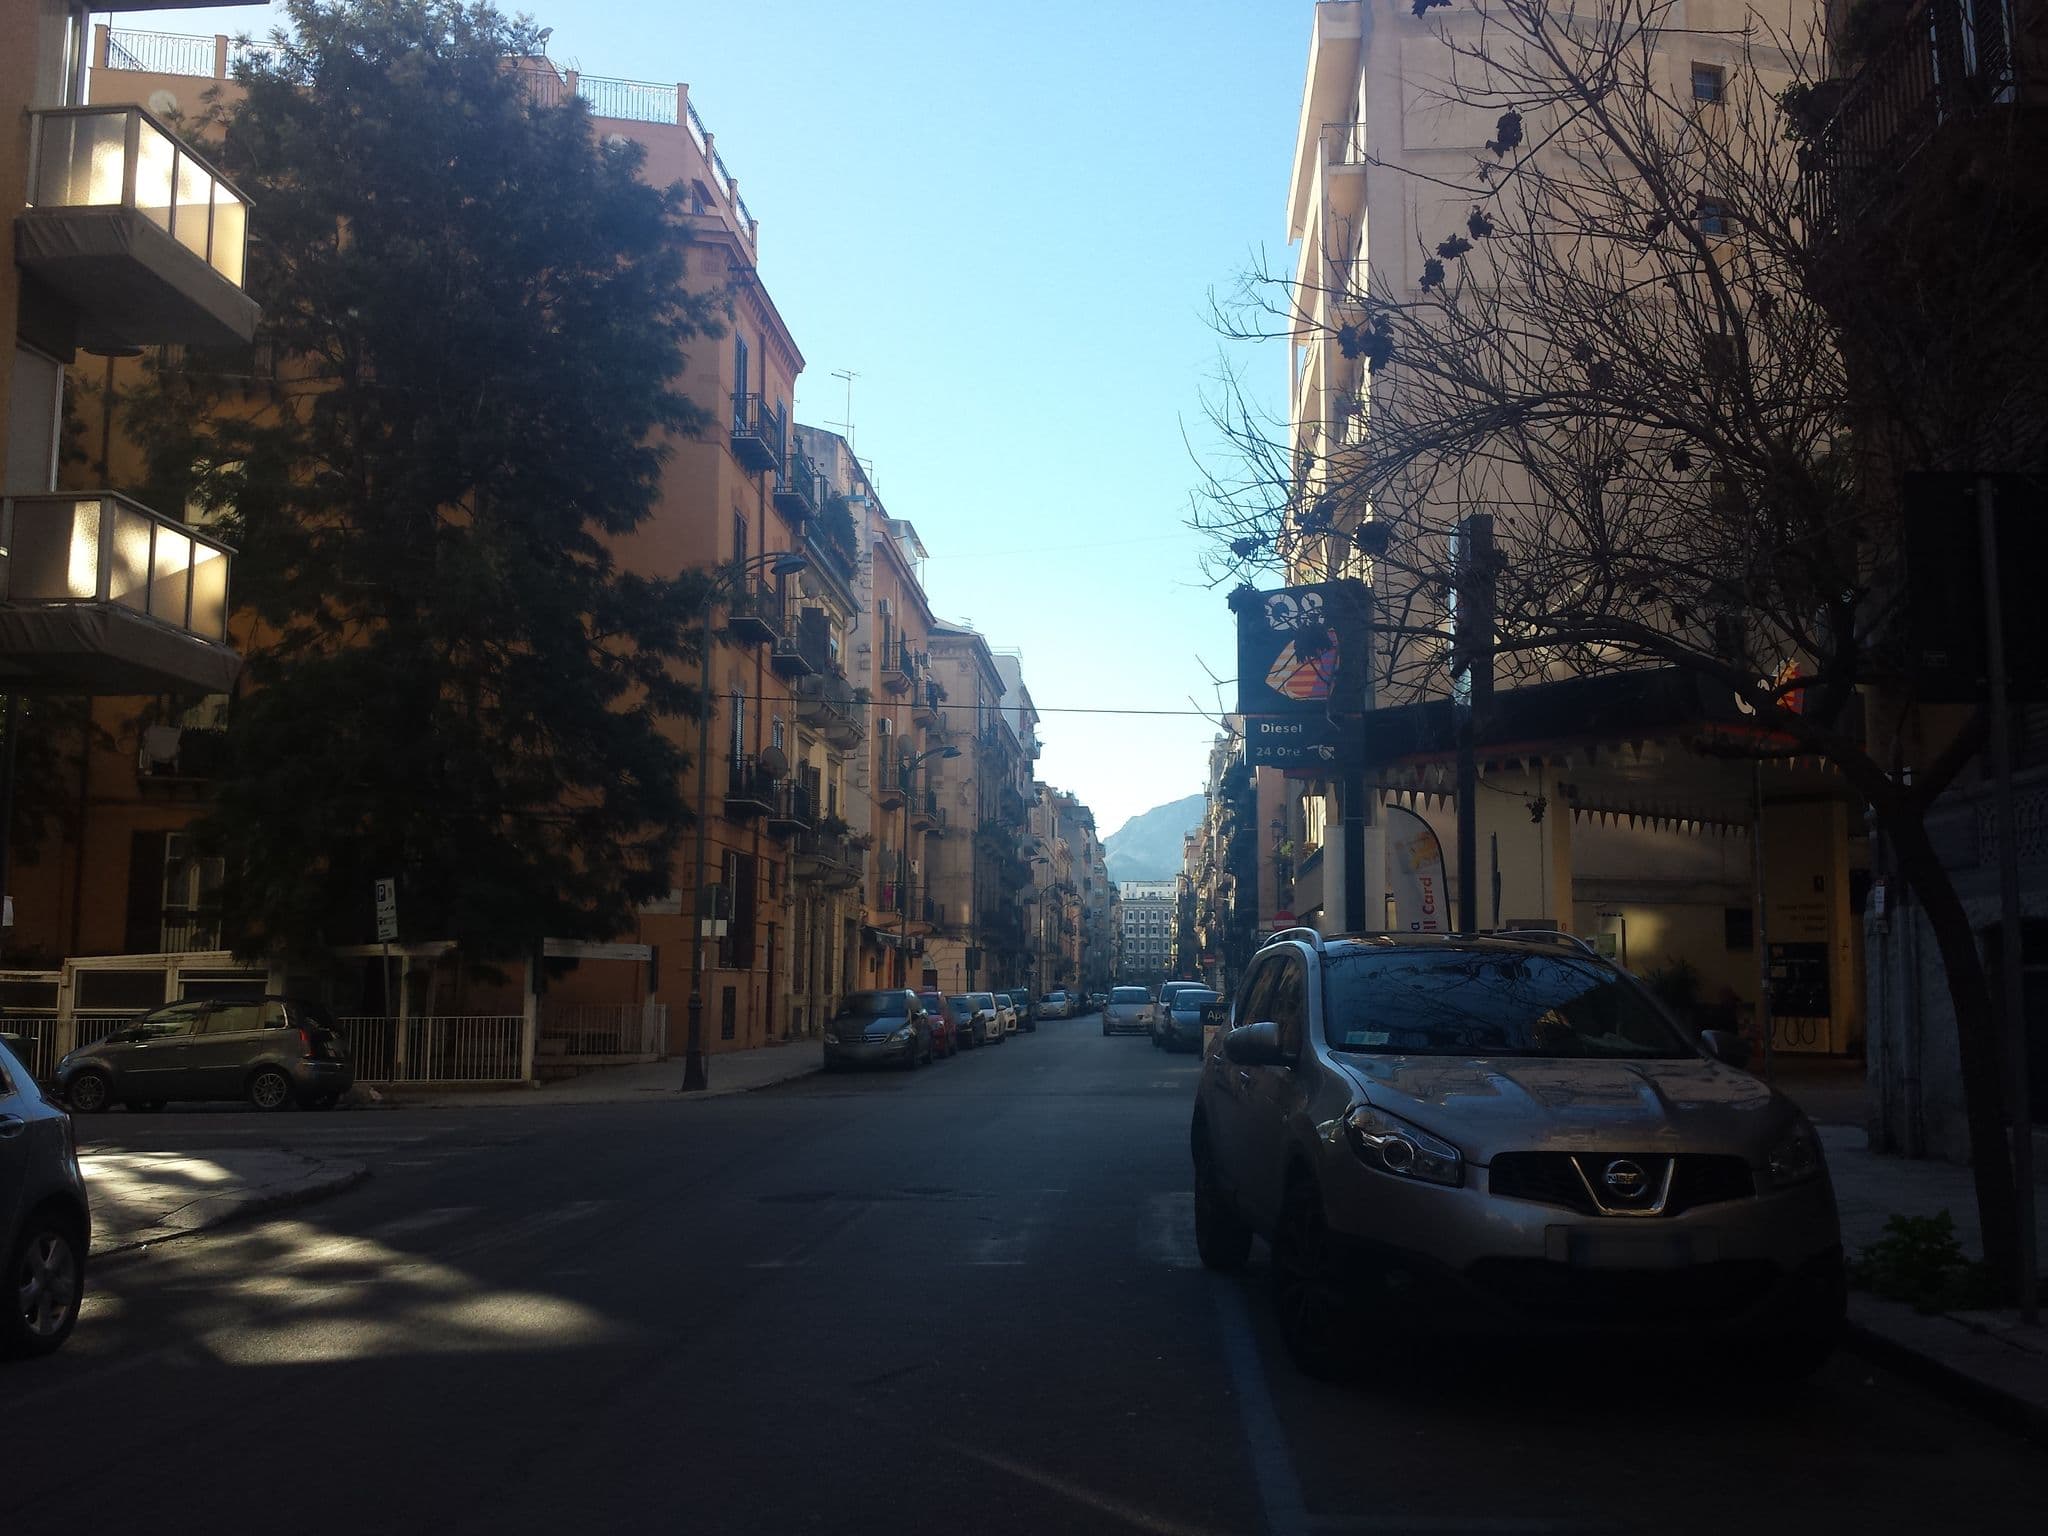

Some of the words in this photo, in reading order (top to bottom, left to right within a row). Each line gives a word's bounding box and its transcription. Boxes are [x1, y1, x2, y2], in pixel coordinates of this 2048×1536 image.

[1260, 723, 1302, 733] Diesel
[1256, 747, 1272, 756] 24
[1277, 746, 1301, 756] Ore
[1420, 877, 1434, 914] Card
[1607, 1173, 1643, 1185] NISS
